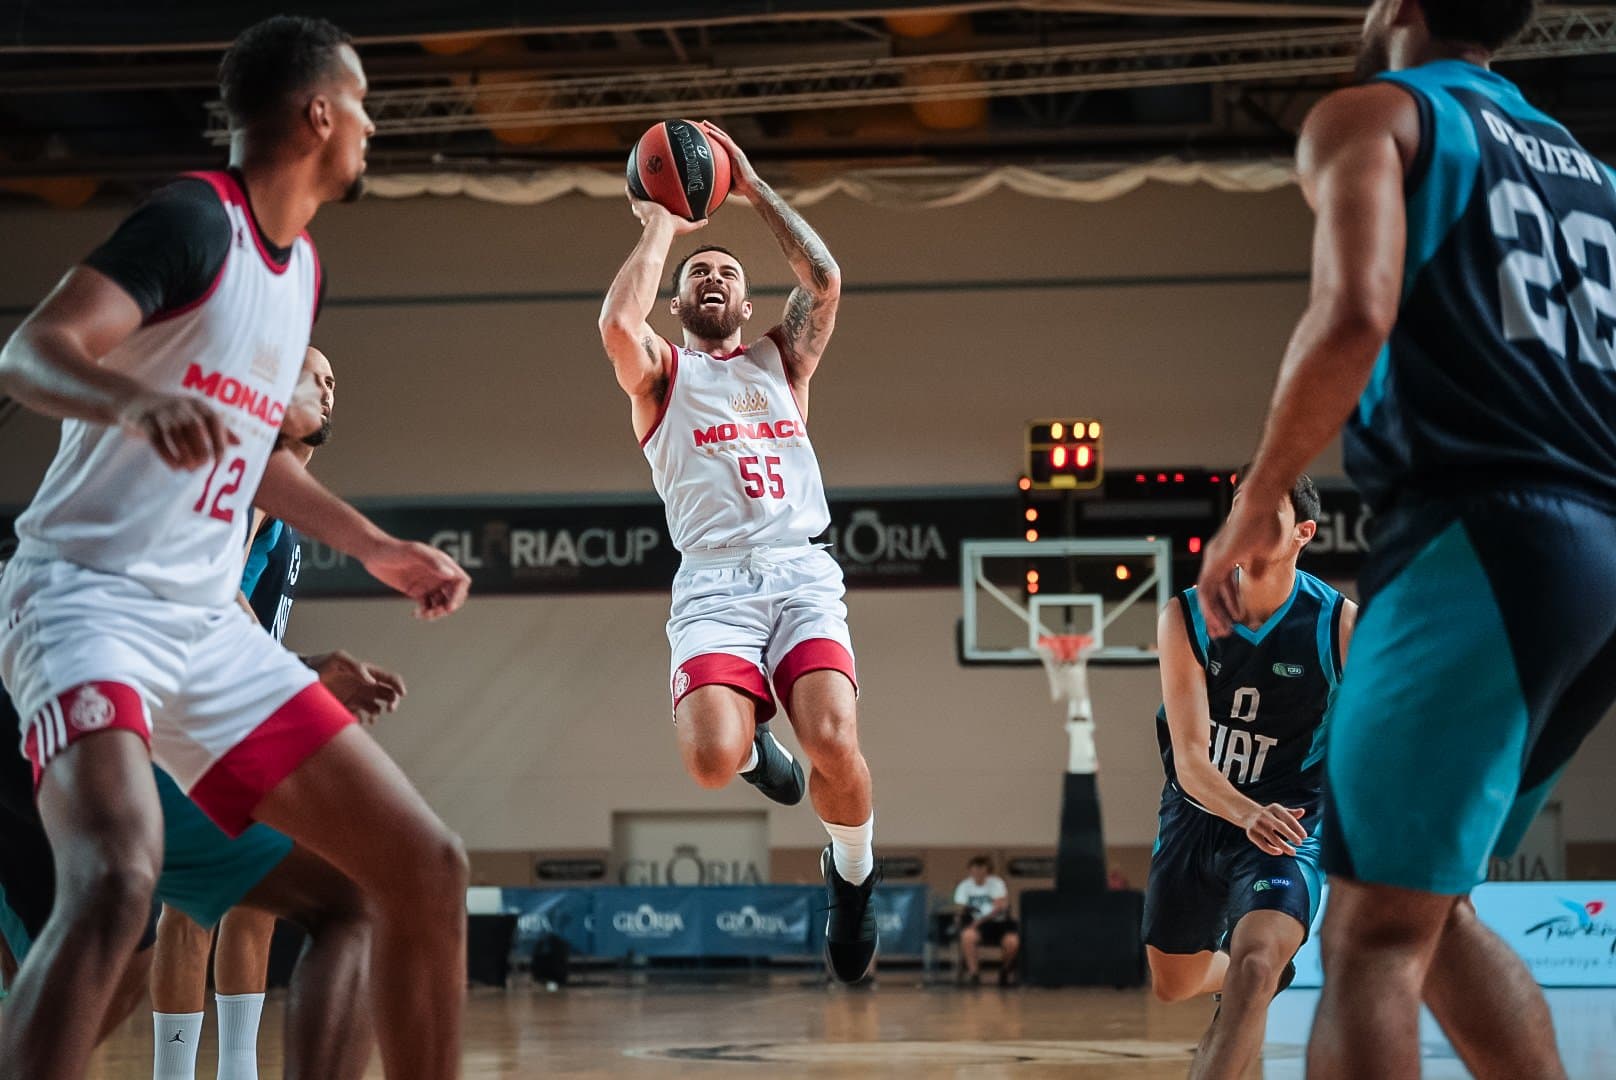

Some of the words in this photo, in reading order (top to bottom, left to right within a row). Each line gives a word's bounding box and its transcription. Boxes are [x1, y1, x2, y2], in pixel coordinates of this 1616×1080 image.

[671, 125, 705, 195] SPALDING
[181, 362, 286, 428] MONAC
[193, 457, 246, 523] 12
[737, 456, 785, 499] 55
[829, 509, 947, 562] LORIA
[1208, 719, 1279, 785] IAT
